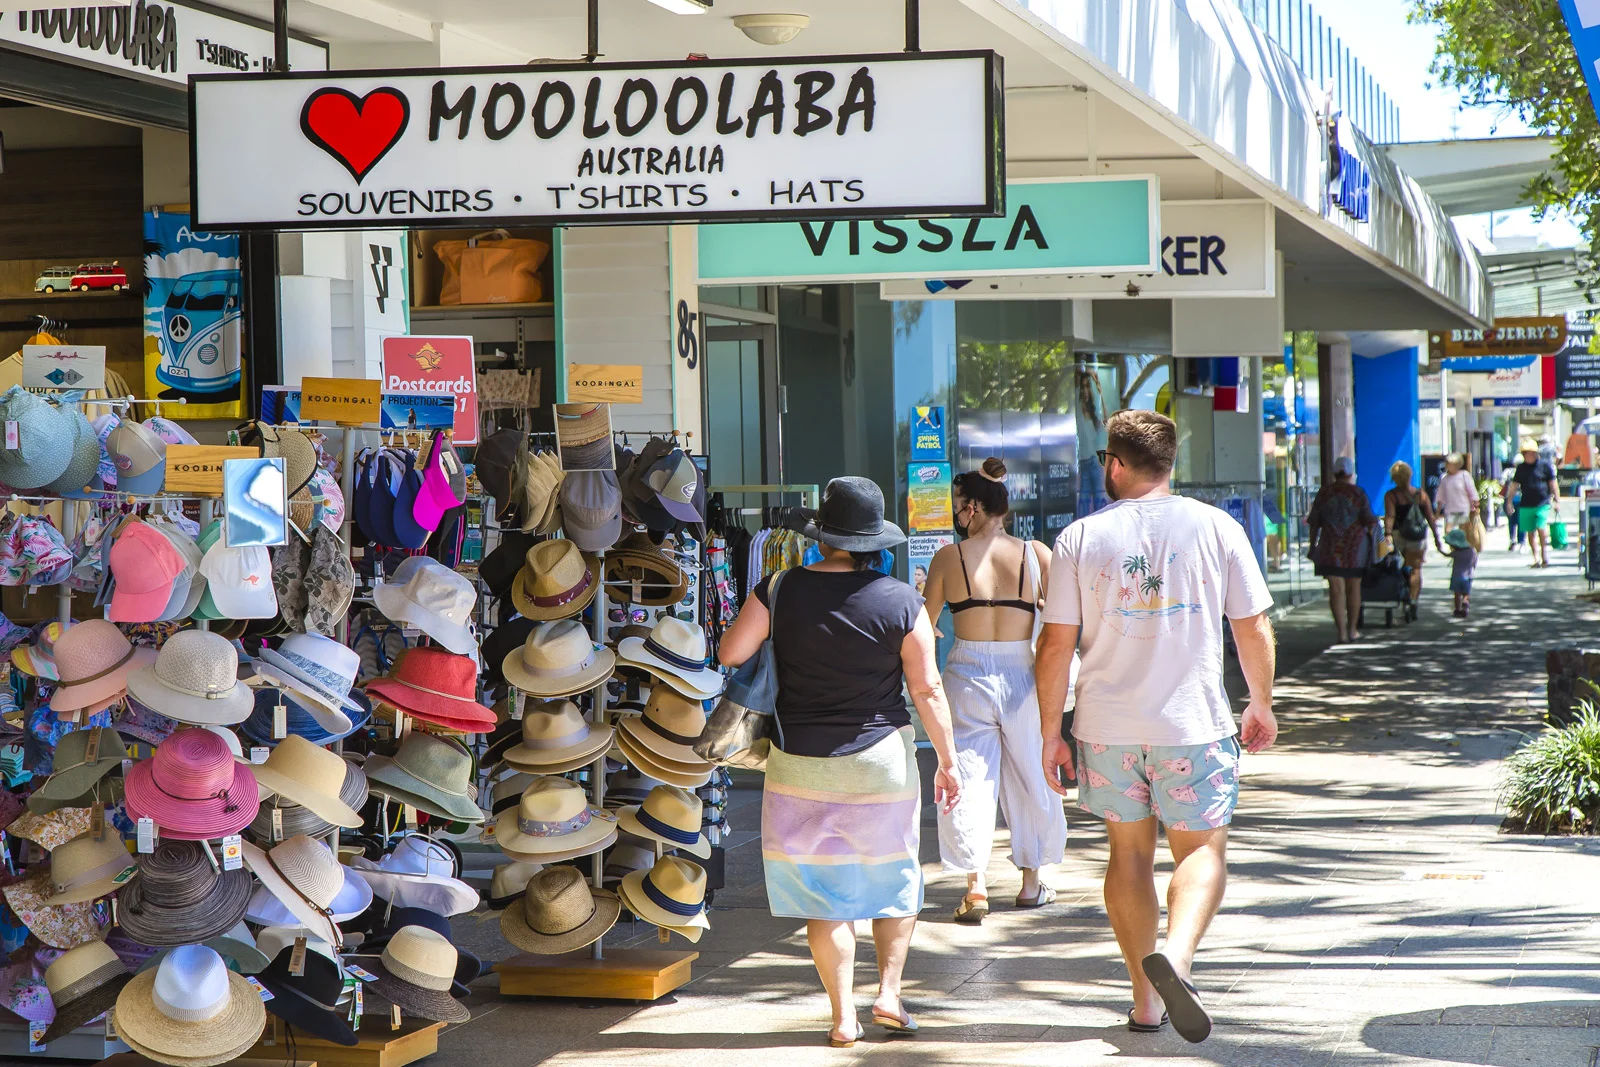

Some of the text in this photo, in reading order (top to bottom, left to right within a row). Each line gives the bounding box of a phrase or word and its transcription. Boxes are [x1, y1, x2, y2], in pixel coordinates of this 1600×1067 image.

[428, 66, 876, 141] MOOLOOLABA
[577, 145, 725, 177] AUSTRALIA
[297, 179, 864, 216] SOUVENIRS T'SHIRTS HATS
[677, 299, 698, 370] 85
[1451, 324, 1559, 342] BEN JERRY'S
[170, 368, 188, 377] OZ-1
[388, 375, 472, 395] Postcards
[308, 395, 373, 405] KOORINGAL
[388, 396, 439, 407] PROJECTION
[917, 434, 940, 444] SWING
[916, 441, 942, 450] PATROL
[174, 464, 224, 473] KOORIN
[910, 544, 930, 552] Hickey
